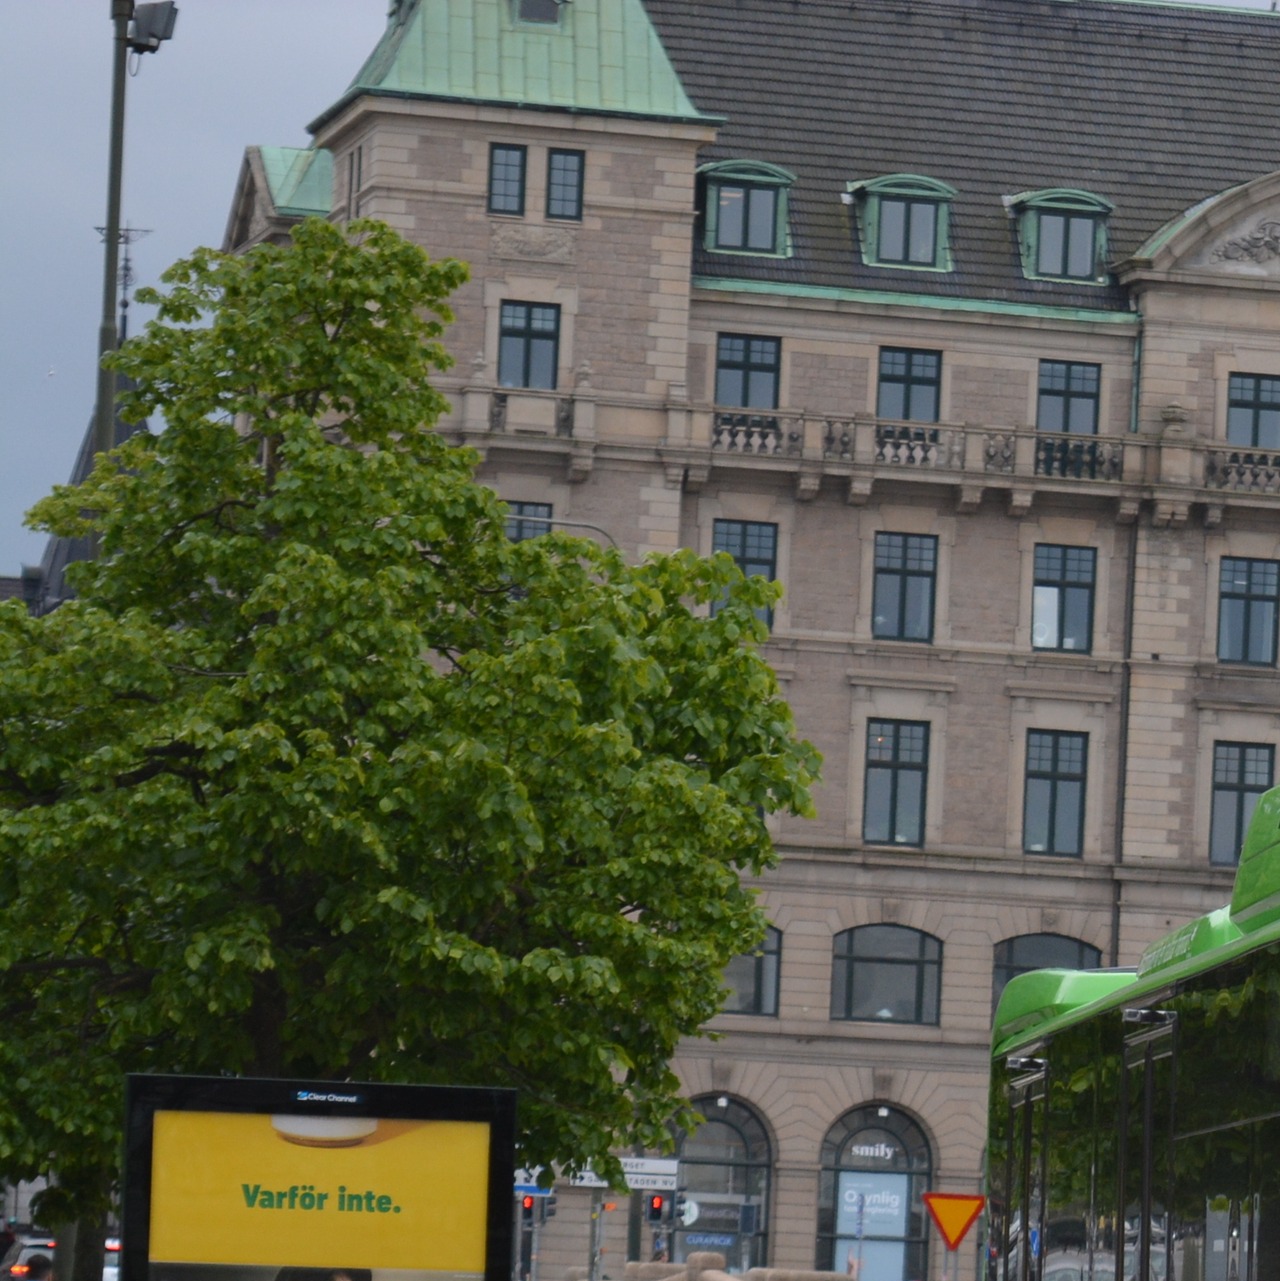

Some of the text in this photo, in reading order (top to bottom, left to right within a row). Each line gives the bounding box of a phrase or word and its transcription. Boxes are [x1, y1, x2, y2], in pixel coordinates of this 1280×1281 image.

[308, 1092, 357, 1103] Clear Channel
[851, 1143, 894, 1159] smily
[241, 1184, 402, 1213] Varför inte.
[844, 1190, 899, 1208] Oynlig
